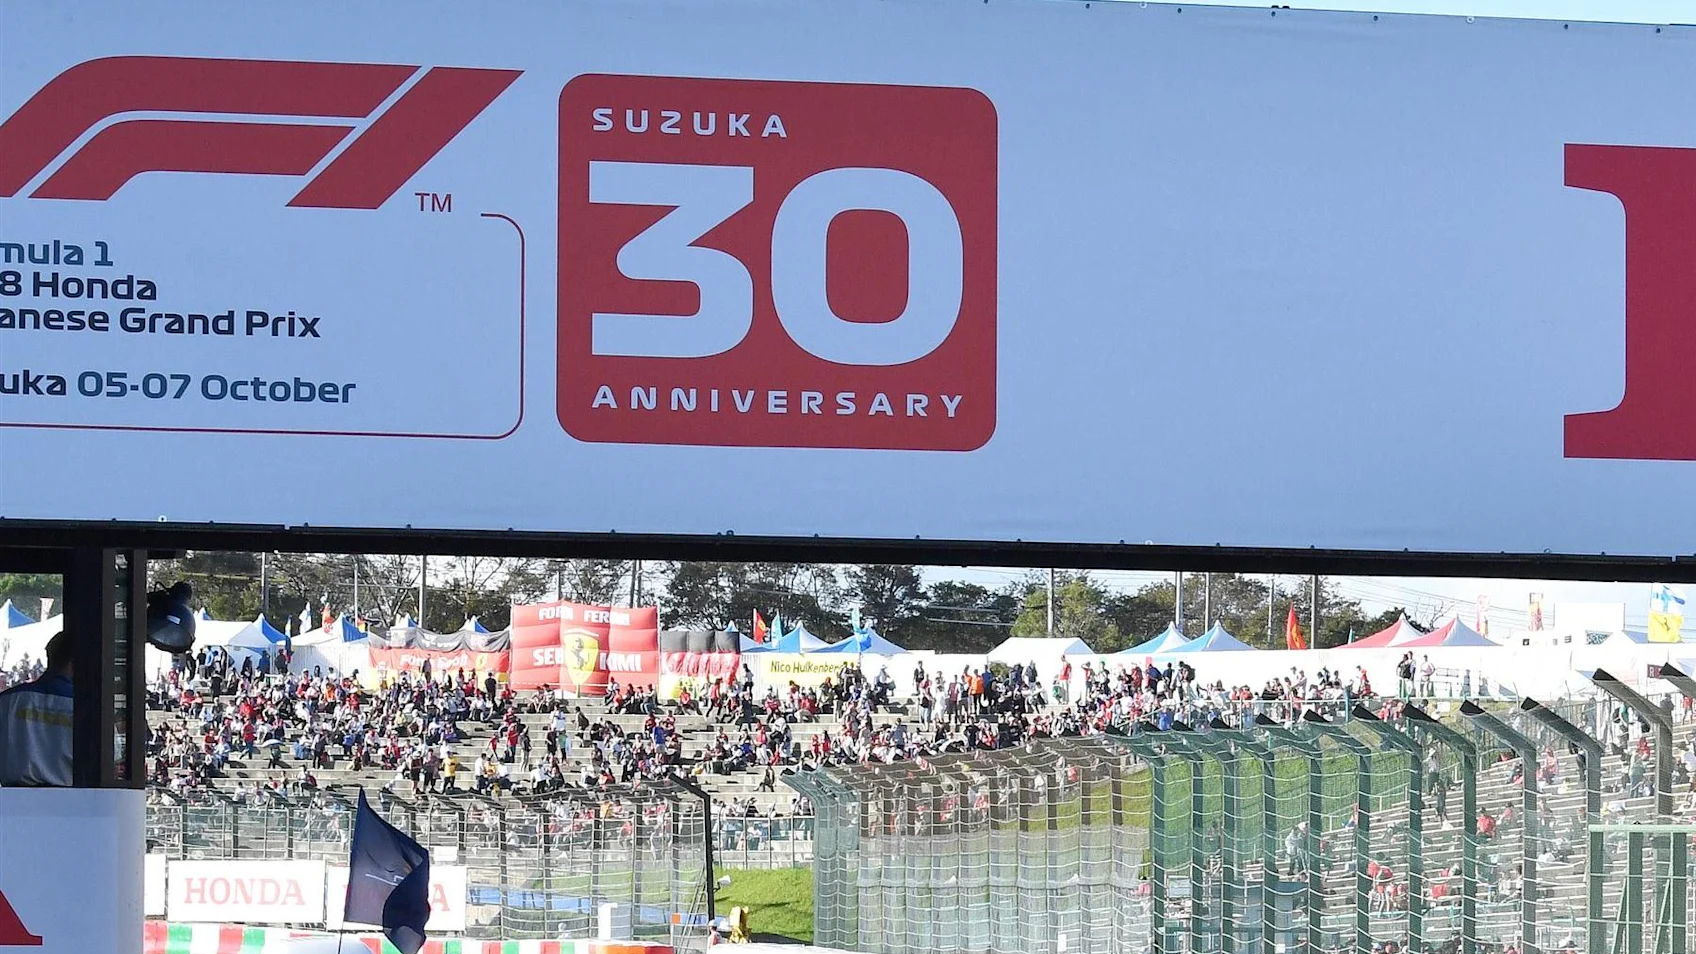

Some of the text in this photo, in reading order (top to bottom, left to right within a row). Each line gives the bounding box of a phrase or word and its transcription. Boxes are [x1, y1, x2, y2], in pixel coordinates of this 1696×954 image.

[591, 107, 788, 139] SUZUKA
[94, 240, 114, 267] 1
[588, 160, 965, 366] 30
[0, 270, 157, 301] 8 Honda
[0, 307, 321, 338] anese Grand Prix
[0, 369, 357, 404] uka 05-07 October
[590, 384, 964, 419] ANNIVERSARY
[770, 660, 844, 675] Nico Hulkenber
[184, 876, 306, 906] HONDA
